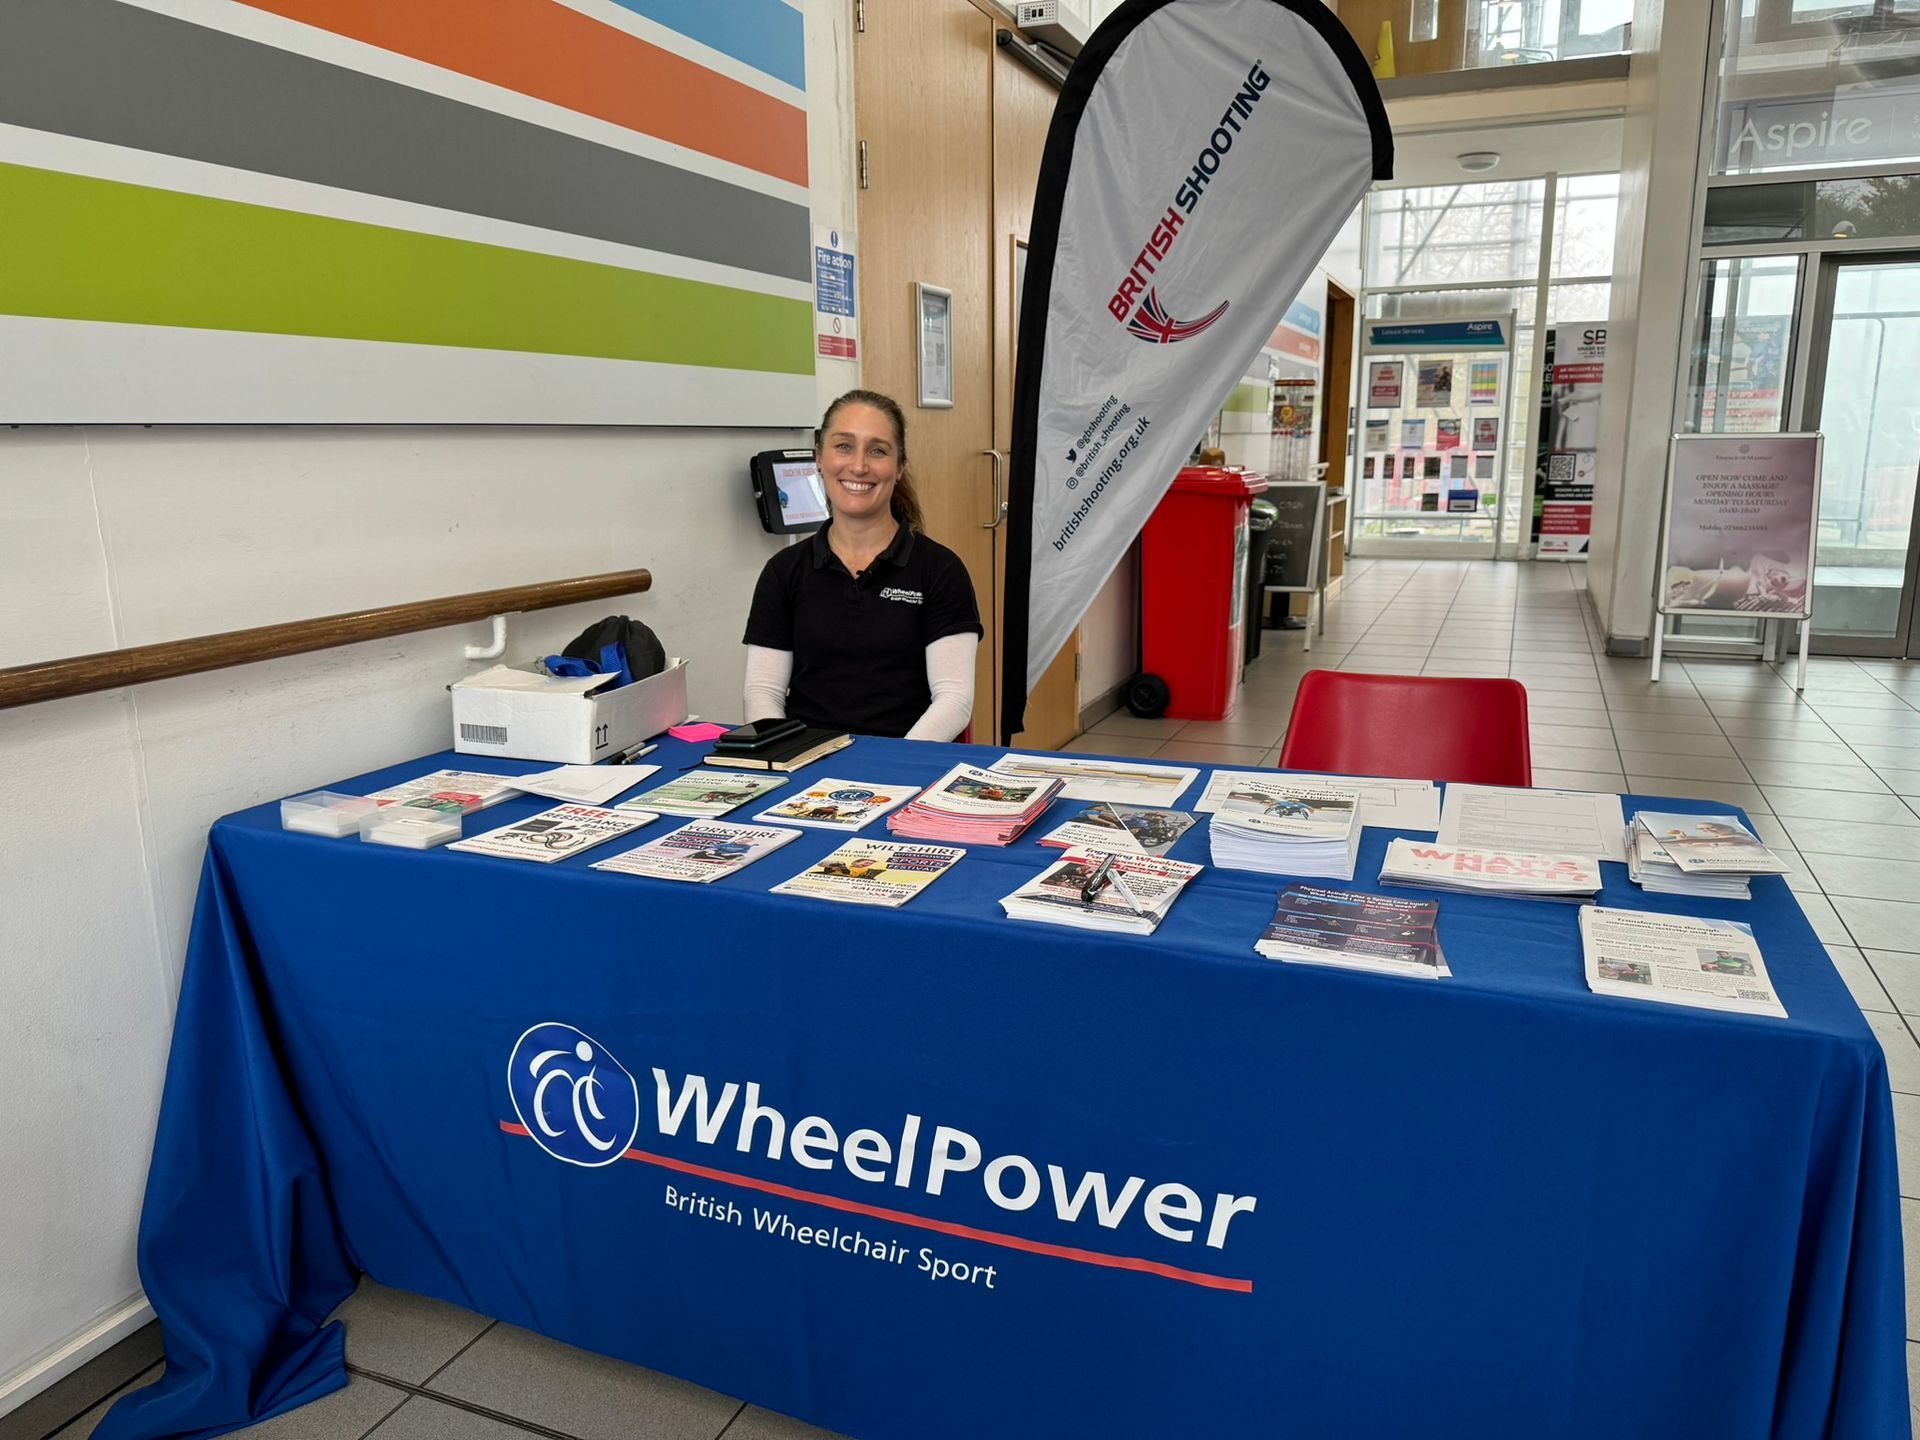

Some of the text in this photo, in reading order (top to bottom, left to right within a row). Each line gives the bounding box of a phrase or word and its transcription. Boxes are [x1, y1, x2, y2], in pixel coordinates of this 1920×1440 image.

[1730, 110, 1873, 158] Aspire
[817, 249, 852, 270] Fire action
[1107, 206, 1185, 323] BRITISH
[1466, 322, 1493, 331] Aspire
[1076, 394, 1118, 449] @gbshooting
[1075, 402, 1131, 478] @british_shooting
[1052, 415, 1151, 552] britishshooting.org.uk
[542, 812, 636, 829] RESISTANCE
[554, 806, 614, 819] FREE
[687, 825, 781, 840] YORKSHIRE
[865, 843, 960, 856] WILTSHIRE
[893, 852, 955, 861] WHEELPOWER
[887, 864, 934, 872] FESTIVAL
[888, 858, 945, 868] SPORTS
[1135, 856, 1197, 870] Wheelchair
[1159, 866, 1191, 874] Sport
[1453, 863, 1589, 883] NEXT?
[851, 885, 911, 895] SALISBURY
[1300, 885, 1326, 893] Physical
[1371, 896, 1392, 904] Spinal
[1617, 918, 1662, 927] Transform
[652, 1066, 1257, 1250] WheelPower
[665, 1185, 998, 1290] British Wheelchair Sport
